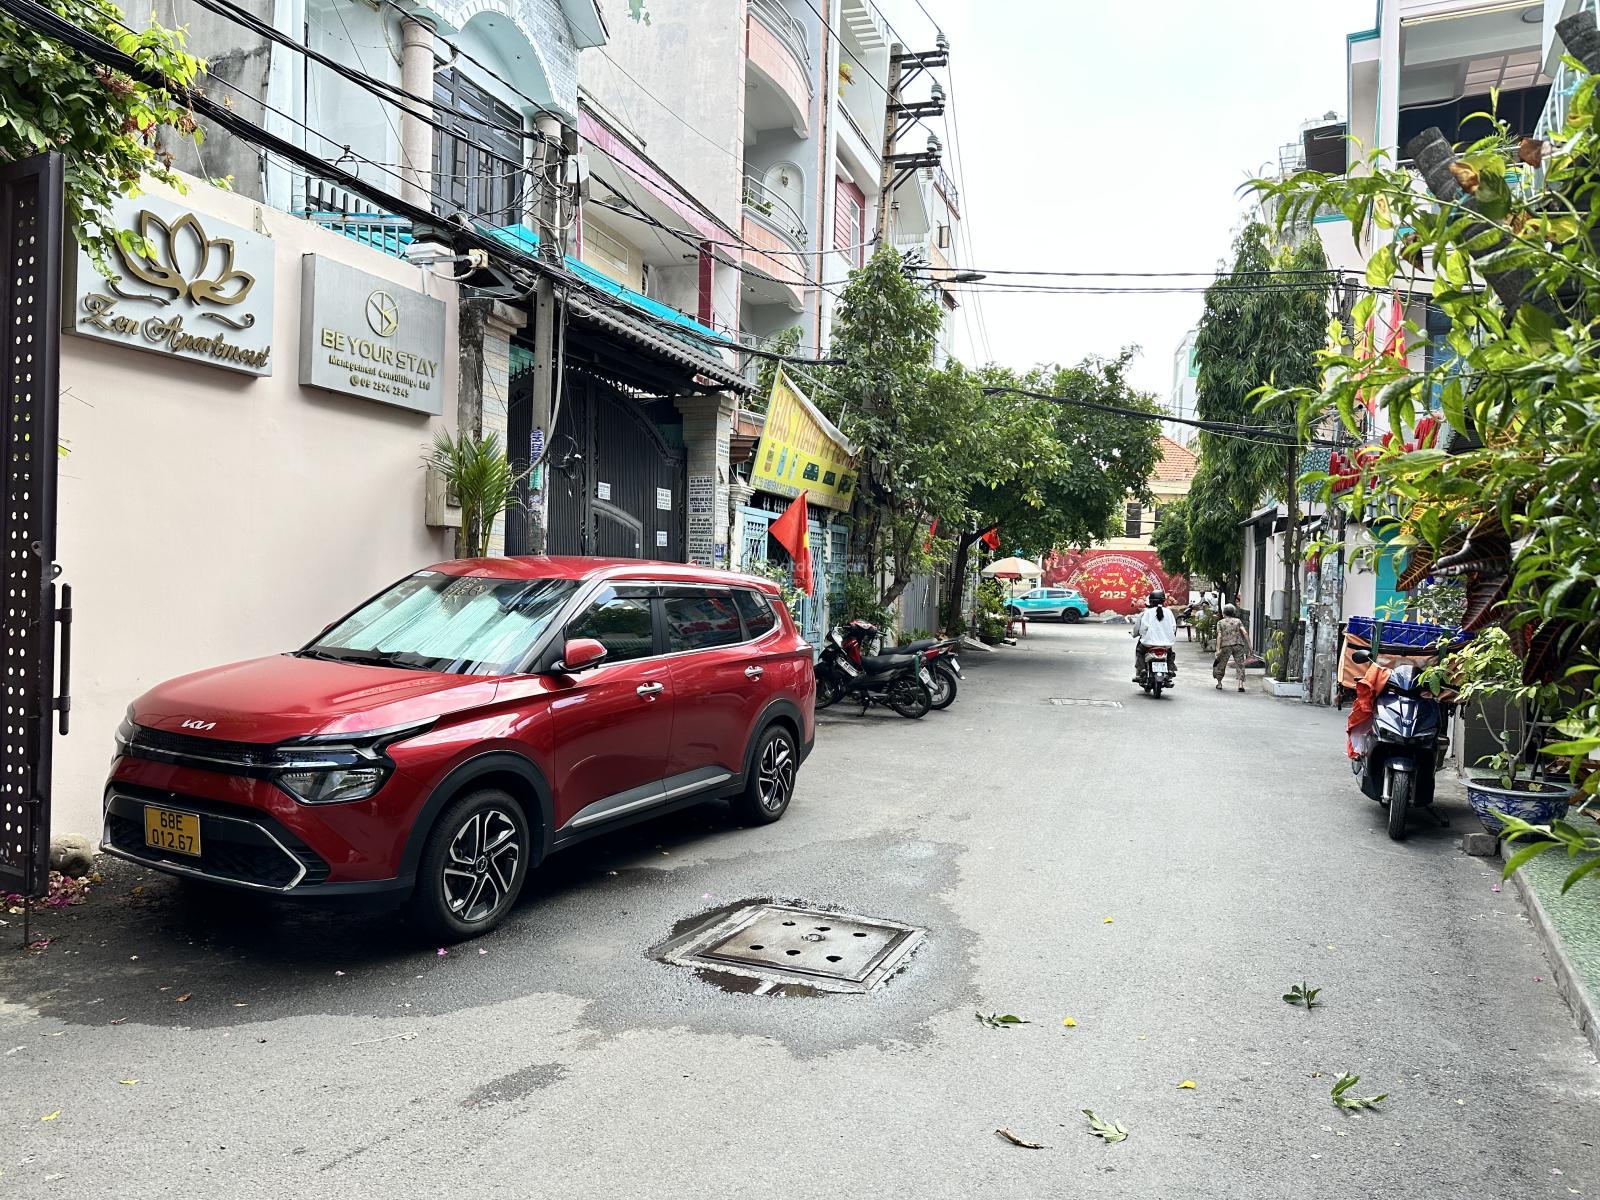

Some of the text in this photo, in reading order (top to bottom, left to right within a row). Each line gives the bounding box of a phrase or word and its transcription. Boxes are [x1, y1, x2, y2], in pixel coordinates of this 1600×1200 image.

[81, 292, 271, 368] Zen Apartment
[321, 327, 439, 378] BE YOUR STAY
[328, 354, 377, 376] Management
[1099, 590, 1127, 600] 2025
[159, 811, 183, 832] 68E
[151, 831, 194, 852] 012.67
